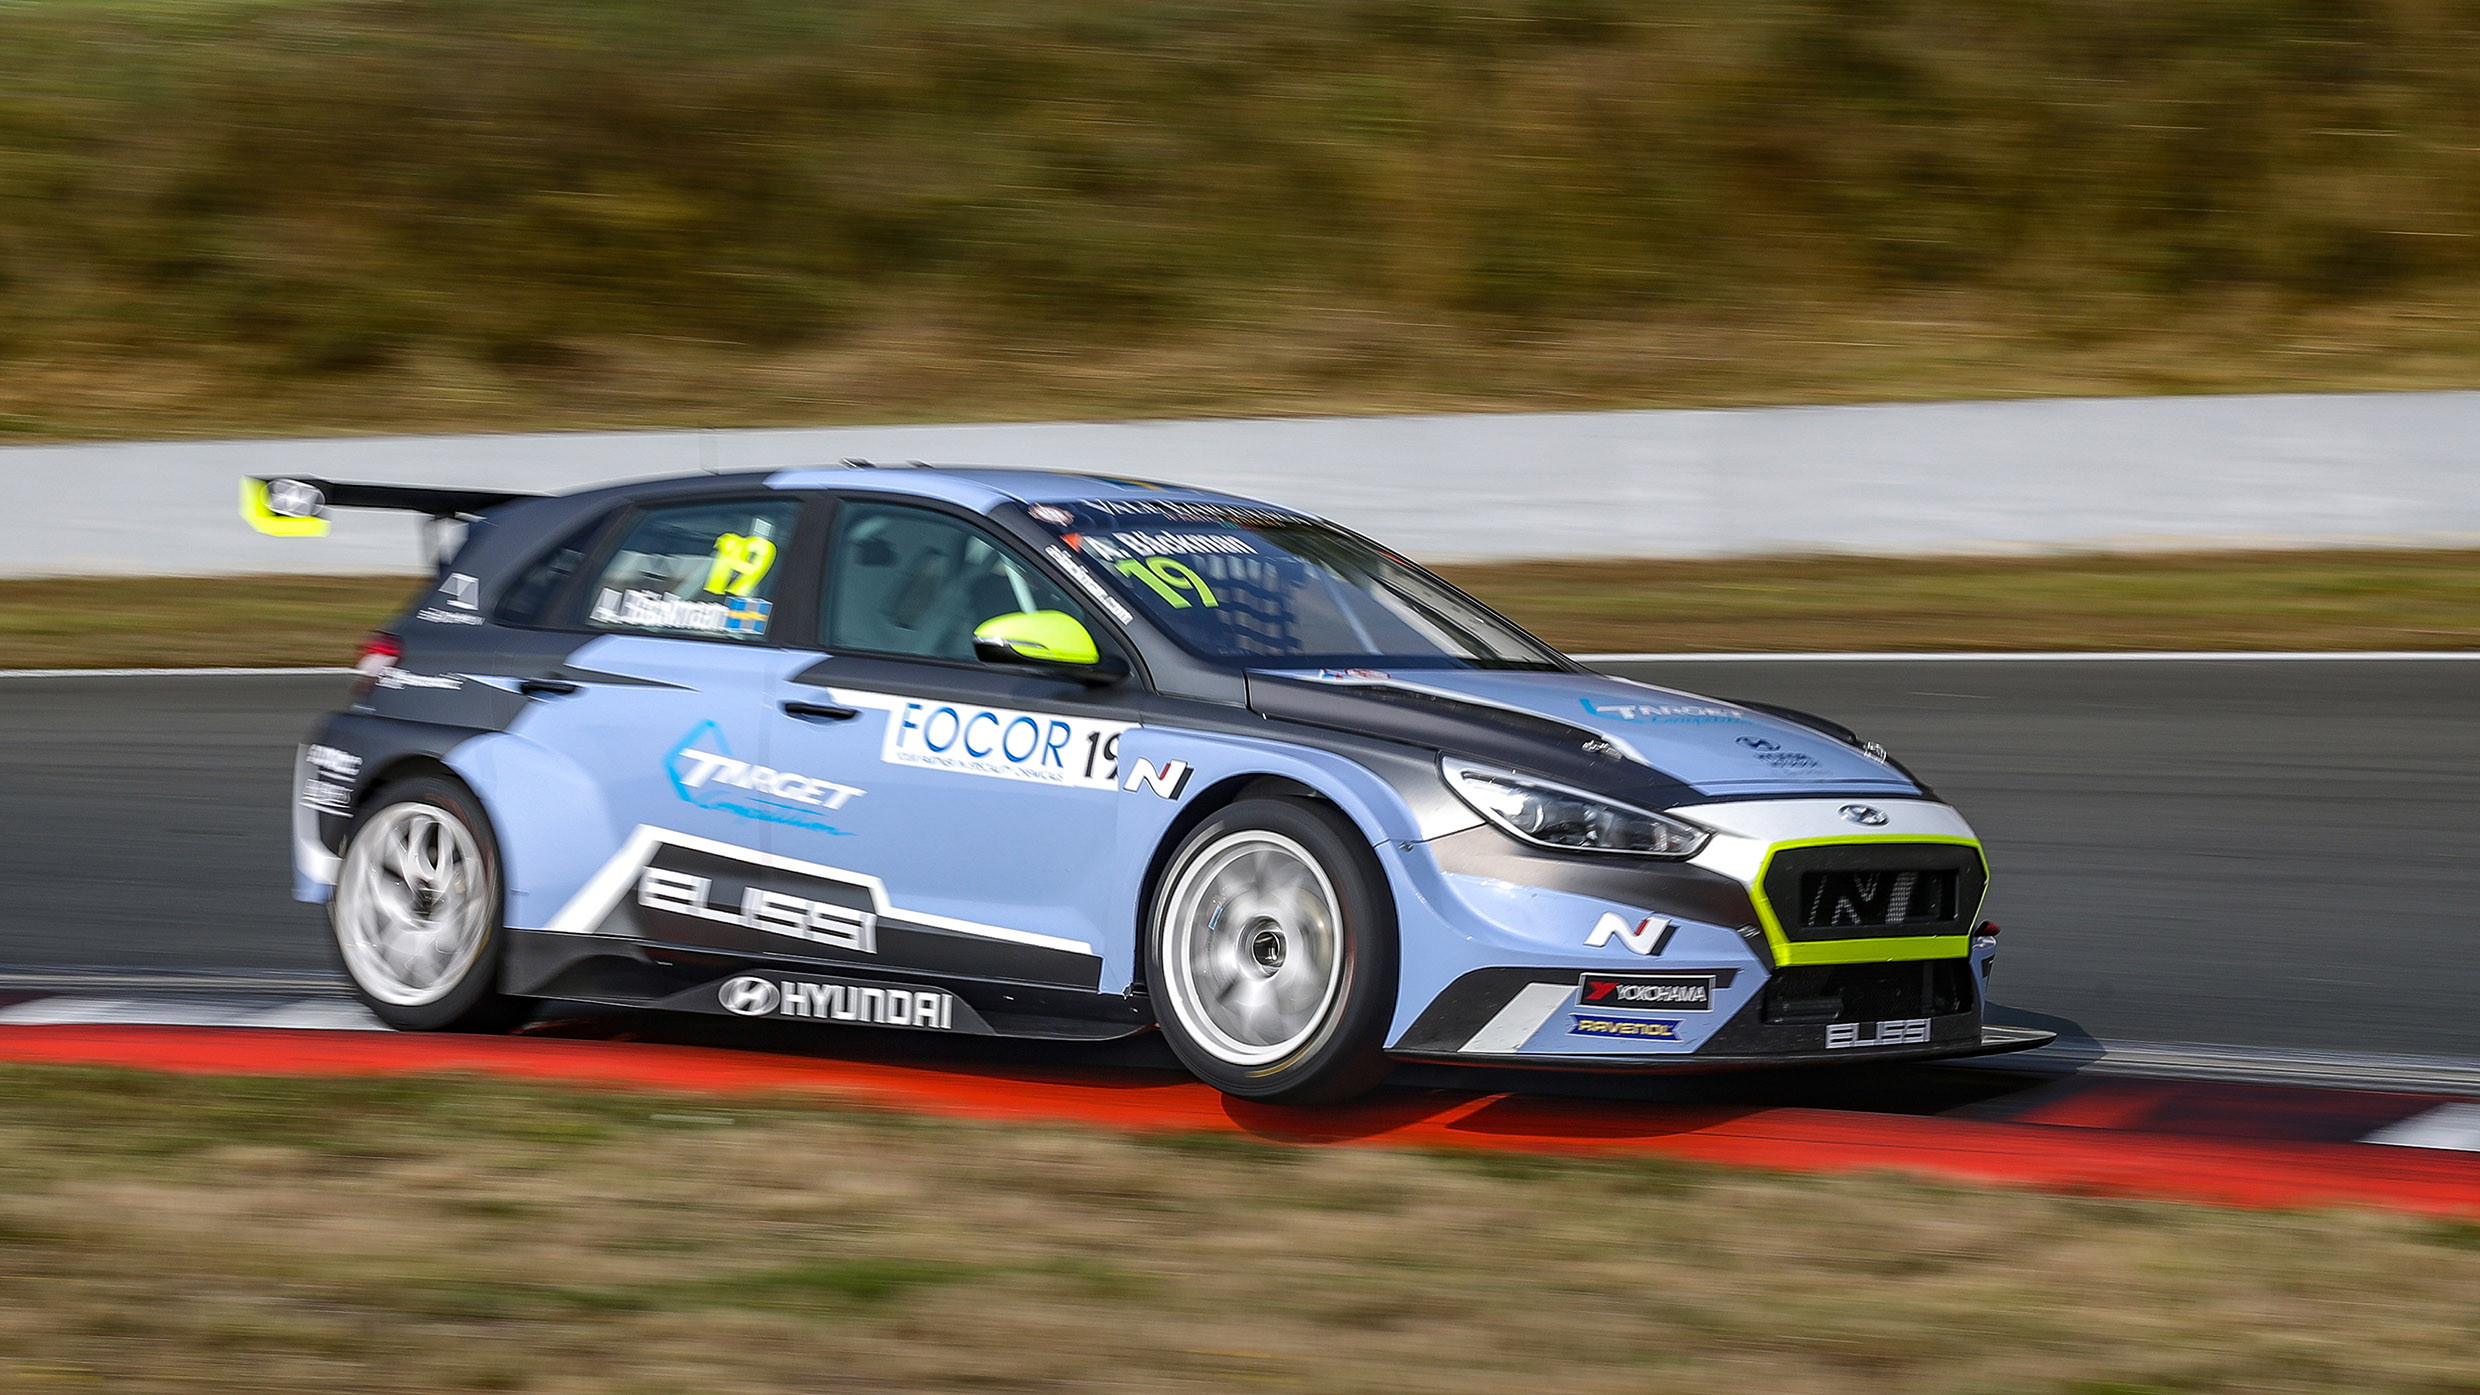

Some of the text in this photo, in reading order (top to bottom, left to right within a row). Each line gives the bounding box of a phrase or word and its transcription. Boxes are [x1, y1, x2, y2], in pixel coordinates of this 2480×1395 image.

[702, 533, 777, 597] 19
[1114, 557, 1219, 609] 19
[896, 702, 1071, 769] FOCOR
[679, 748, 868, 810] TARGET
[780, 980, 953, 1029] HYUNDAI
[1617, 984, 1707, 1003] YOKOHAMA
[1578, 1019, 1674, 1037] RAVENOL
